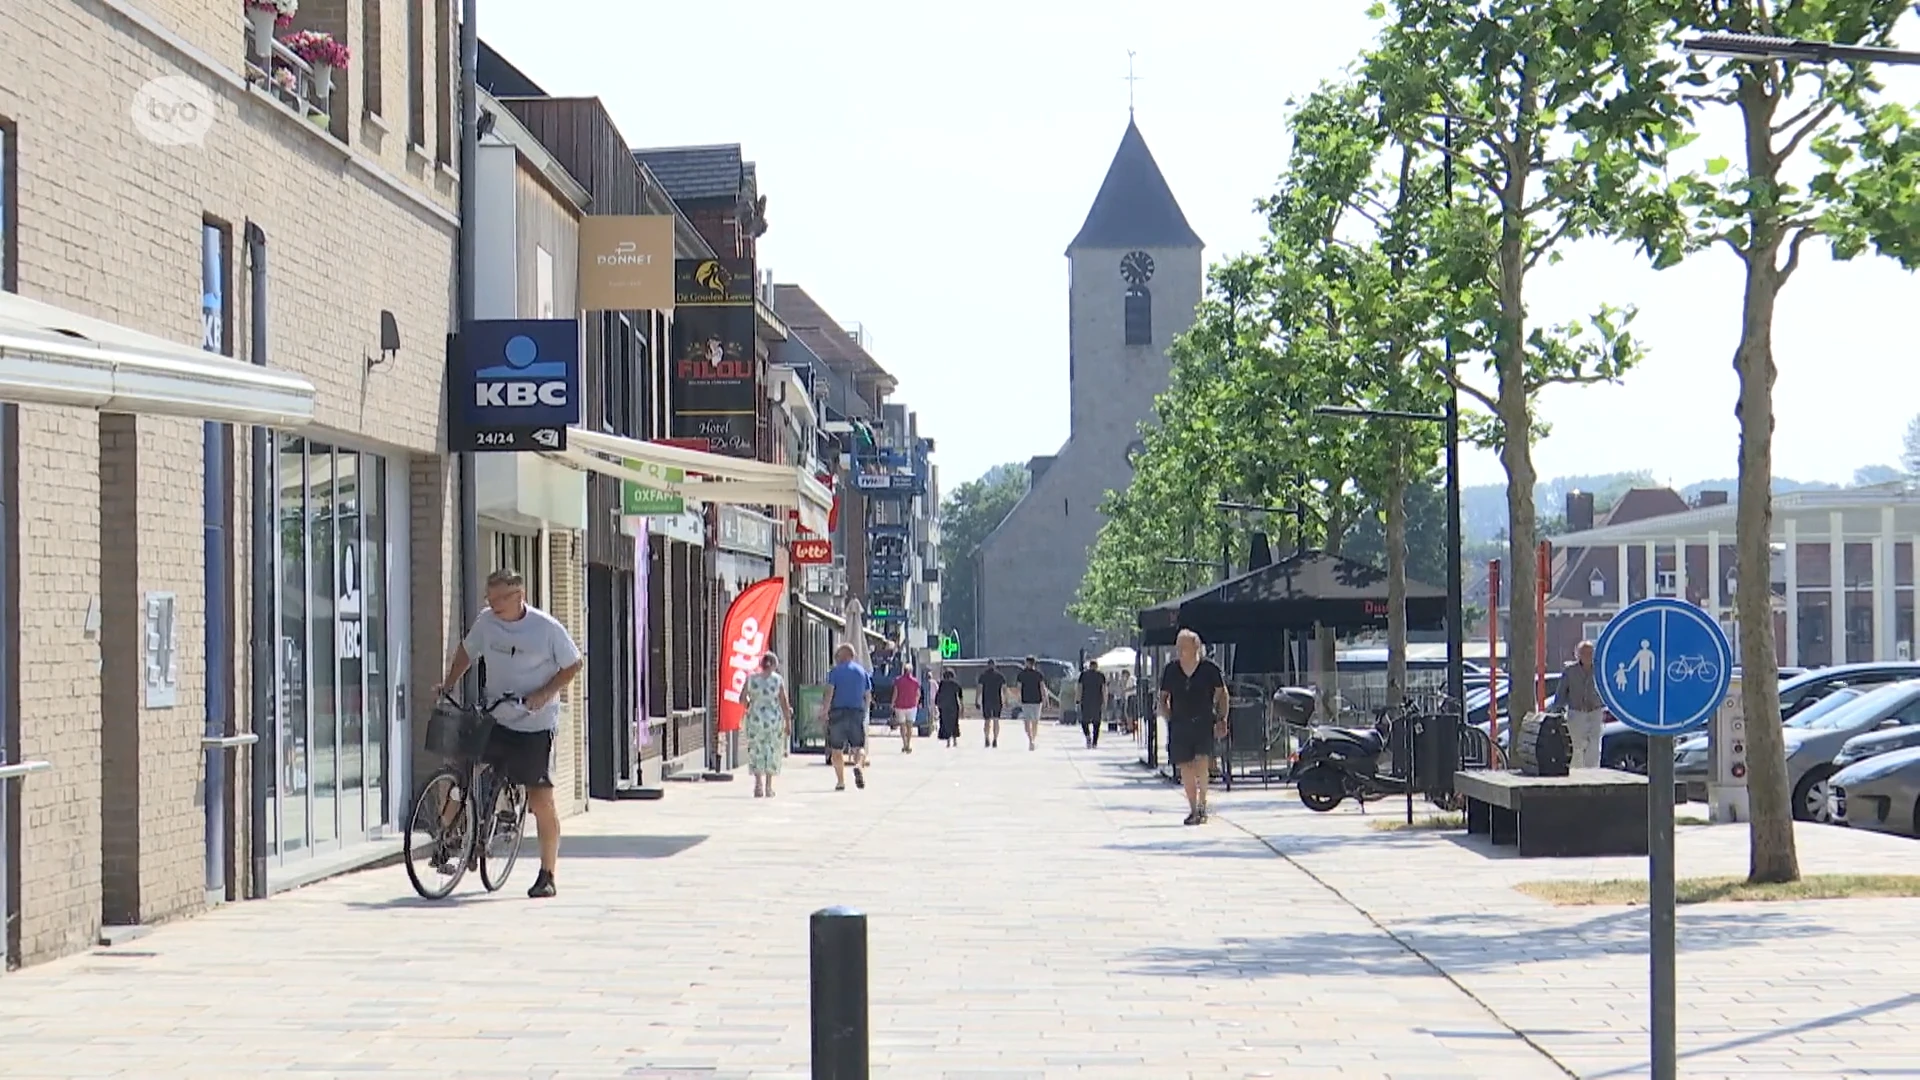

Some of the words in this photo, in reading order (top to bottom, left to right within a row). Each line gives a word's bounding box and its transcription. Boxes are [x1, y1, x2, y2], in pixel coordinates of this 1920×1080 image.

[678, 360, 752, 379] FILOU
[476, 381, 566, 406] KBC
[699, 419, 731, 434] Hotel
[476, 432, 515, 445] 24/24
[724, 616, 764, 704] lotto
